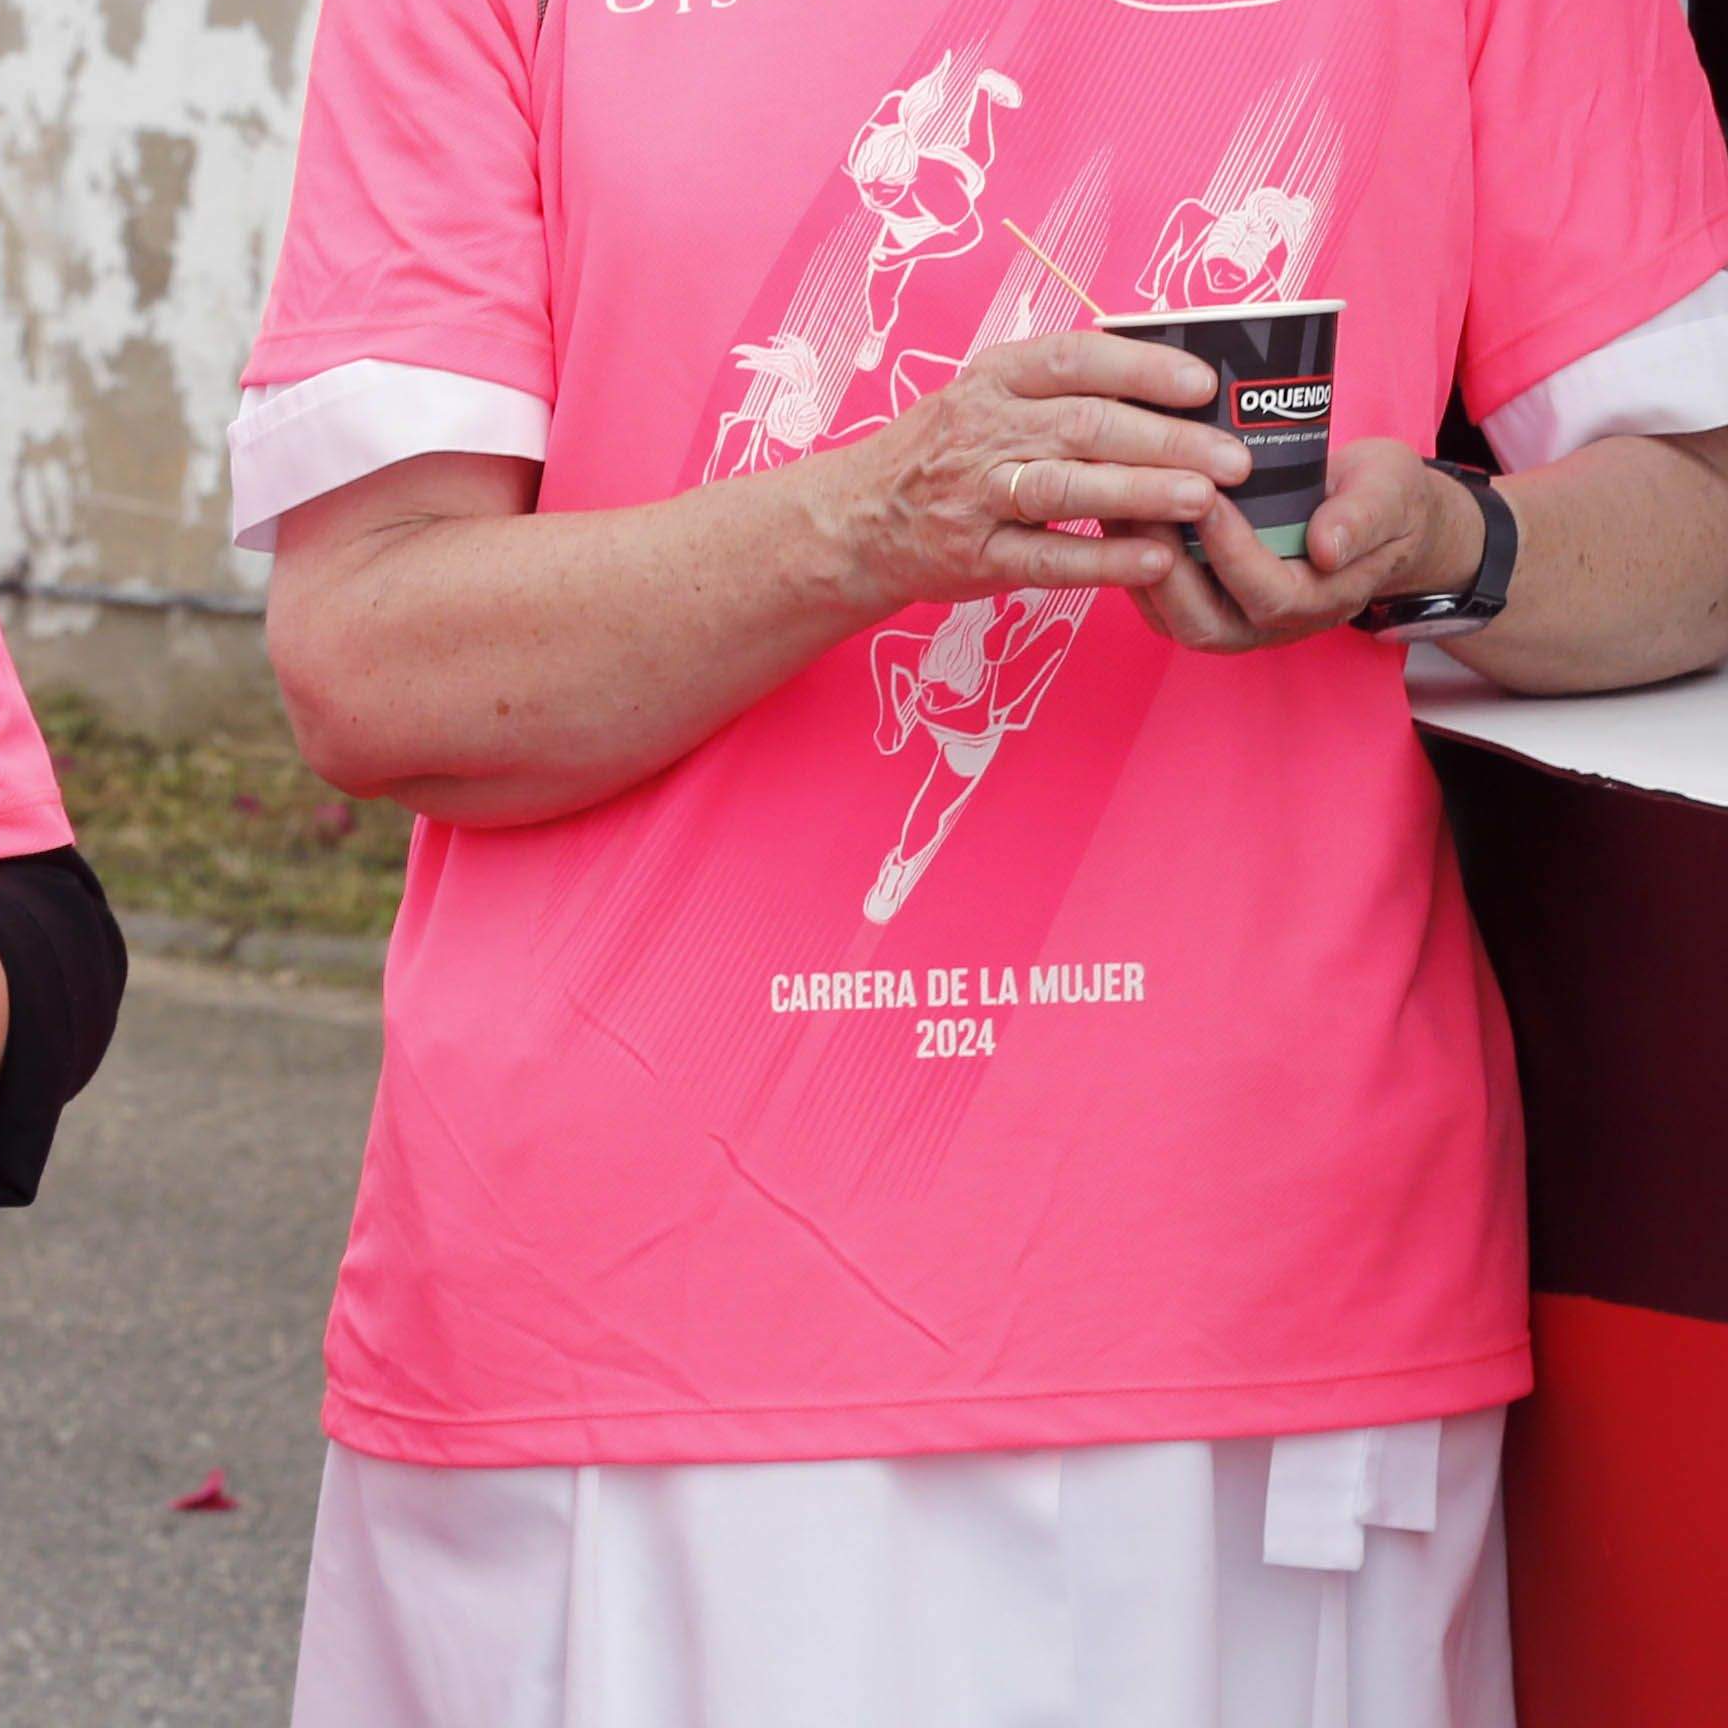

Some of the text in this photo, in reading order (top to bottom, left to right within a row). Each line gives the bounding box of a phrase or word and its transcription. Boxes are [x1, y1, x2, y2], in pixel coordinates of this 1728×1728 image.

[1240, 383, 1332, 417] OQUENDO
[770, 962, 1146, 1013] CARRERA DE LA MUJER
[915, 1017, 996, 1059] 2024
